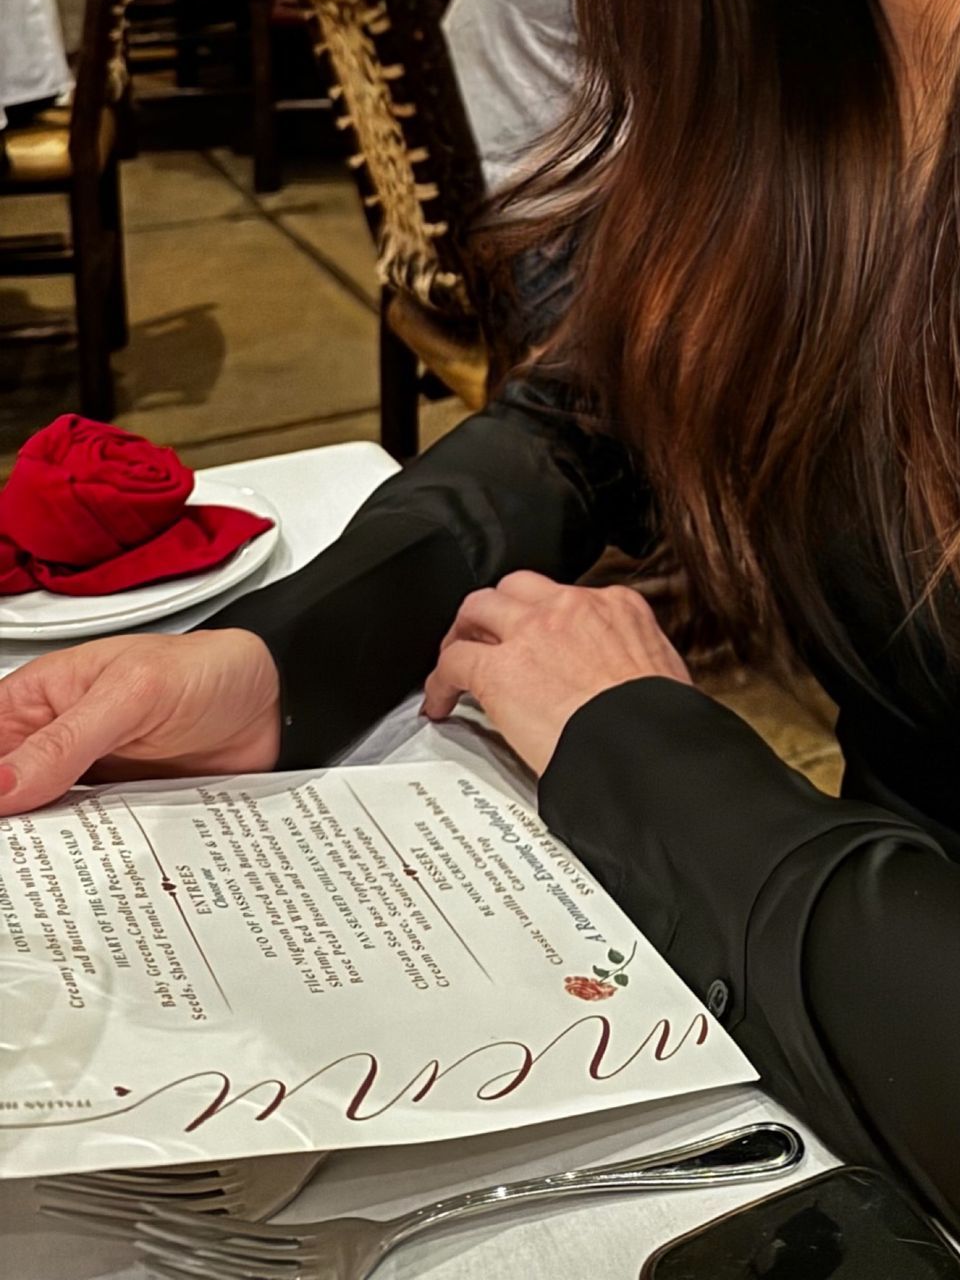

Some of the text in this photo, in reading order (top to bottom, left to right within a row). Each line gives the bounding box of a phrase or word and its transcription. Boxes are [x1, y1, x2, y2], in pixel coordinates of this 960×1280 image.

[106, 826, 125, 846] Rose
[191, 818, 213, 839] TURF
[226, 808, 255, 839] Served
[321, 816, 347, 839] Petal
[439, 815, 460, 835] with
[29, 835, 54, 872] Lobster
[204, 840, 218, 849] &
[326, 849, 347, 869] with
[341, 839, 362, 861] Rose
[353, 826, 390, 870] Asparagus
[451, 834, 488, 870] Custard
[457, 778, 607, 943] A Romantic Evening Crafted for Two
[538, 839, 564, 859] PER
[15, 867, 36, 889] with
[118, 848, 149, 899] Raspberry
[356, 862, 378, 884] Over
[409, 847, 454, 892] DESSERT
[476, 836, 526, 892] Caramel Top
[40, 874, 72, 916] Poached
[175, 864, 213, 915] ENTREES
[243, 870, 265, 892] with
[281, 816, 376, 950] PAN SEARED CHILEAN SEA BASS
[283, 872, 306, 890] and
[338, 870, 372, 905] Topped
[484, 870, 507, 894] Bean
[24, 890, 49, 919] Broth
[59, 829, 131, 968] HEART OF THE GARDEN SALAD
[254, 893, 285, 926] Paired
[282, 898, 303, 923] Wine
[300, 892, 329, 928] Risotto
[369, 884, 402, 918] Served
[478, 904, 496, 917] BE
[502, 894, 533, 929] Vanilla
[138, 901, 168, 940] Fennel,
[246, 920, 264, 934] OF
[366, 905, 389, 929] Bass
[409, 909, 433, 932] with
[40, 921, 68, 963] Lobster
[62, 918, 87, 953] Butter
[255, 936, 278, 958] DUO
[278, 928, 309, 966] Mignon
[295, 924, 317, 944] Red
[318, 930, 347, 956] Petal
[383, 929, 402, 948] Sea
[398, 918, 426, 952] Sauce,
[530, 929, 564, 966] Classic
[73, 954, 97, 975] and
[155, 942, 188, 980] Shaved
[313, 945, 344, 988] Shrimp,
[340, 958, 364, 984] Rose
[396, 949, 430, 990] Chilean
[420, 953, 450, 988] Cream
[59, 966, 86, 1009] Creamy
[153, 980, 177, 1008] Baby
[300, 968, 325, 994] Filet
[180, 983, 208, 1021] Seeds,
[120, 1014, 709, 1134] menu
